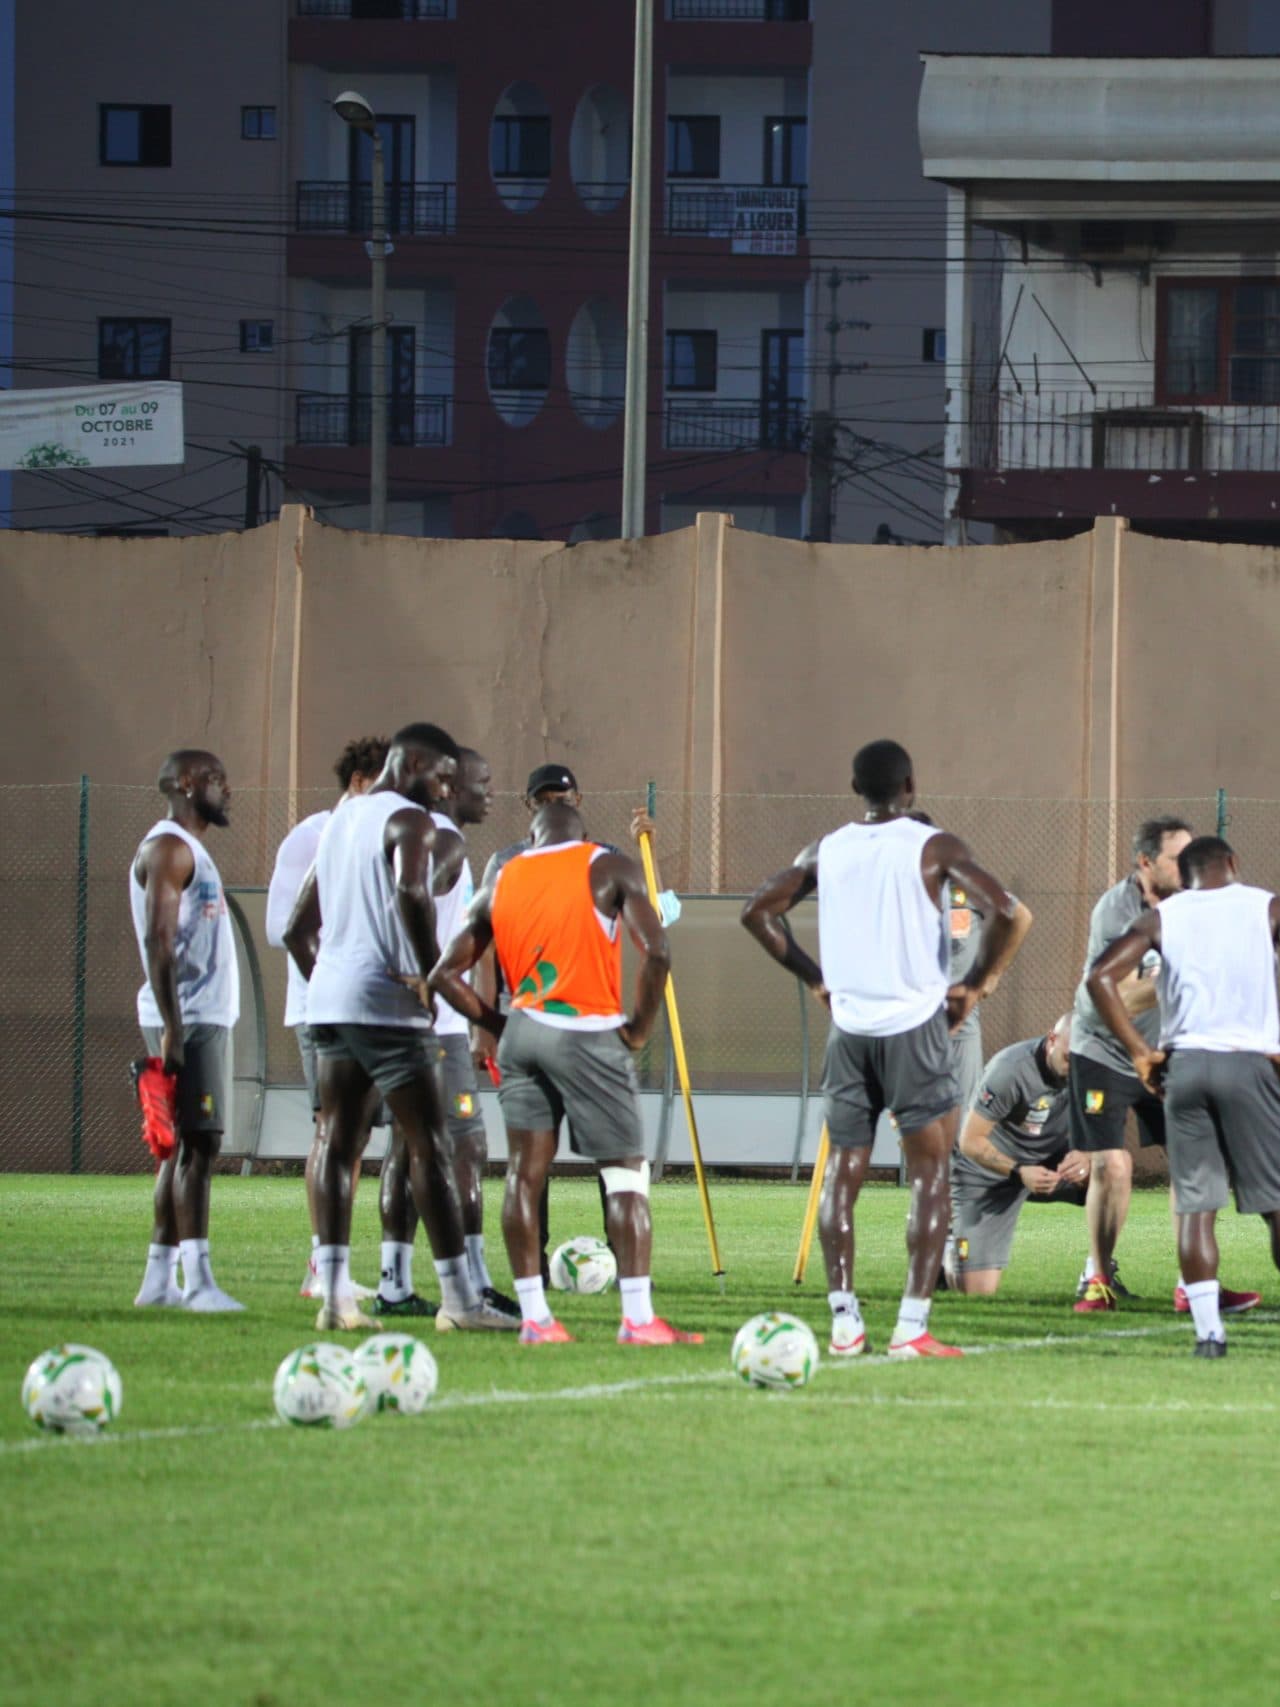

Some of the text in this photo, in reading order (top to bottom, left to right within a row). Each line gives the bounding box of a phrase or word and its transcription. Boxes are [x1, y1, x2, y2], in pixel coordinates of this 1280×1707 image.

[750, 211, 794, 230] LOUER
[75, 401, 159, 417] Du 07 au 09
[81, 419, 153, 433] OCTOBRE
[104, 437, 135, 447] 2021
